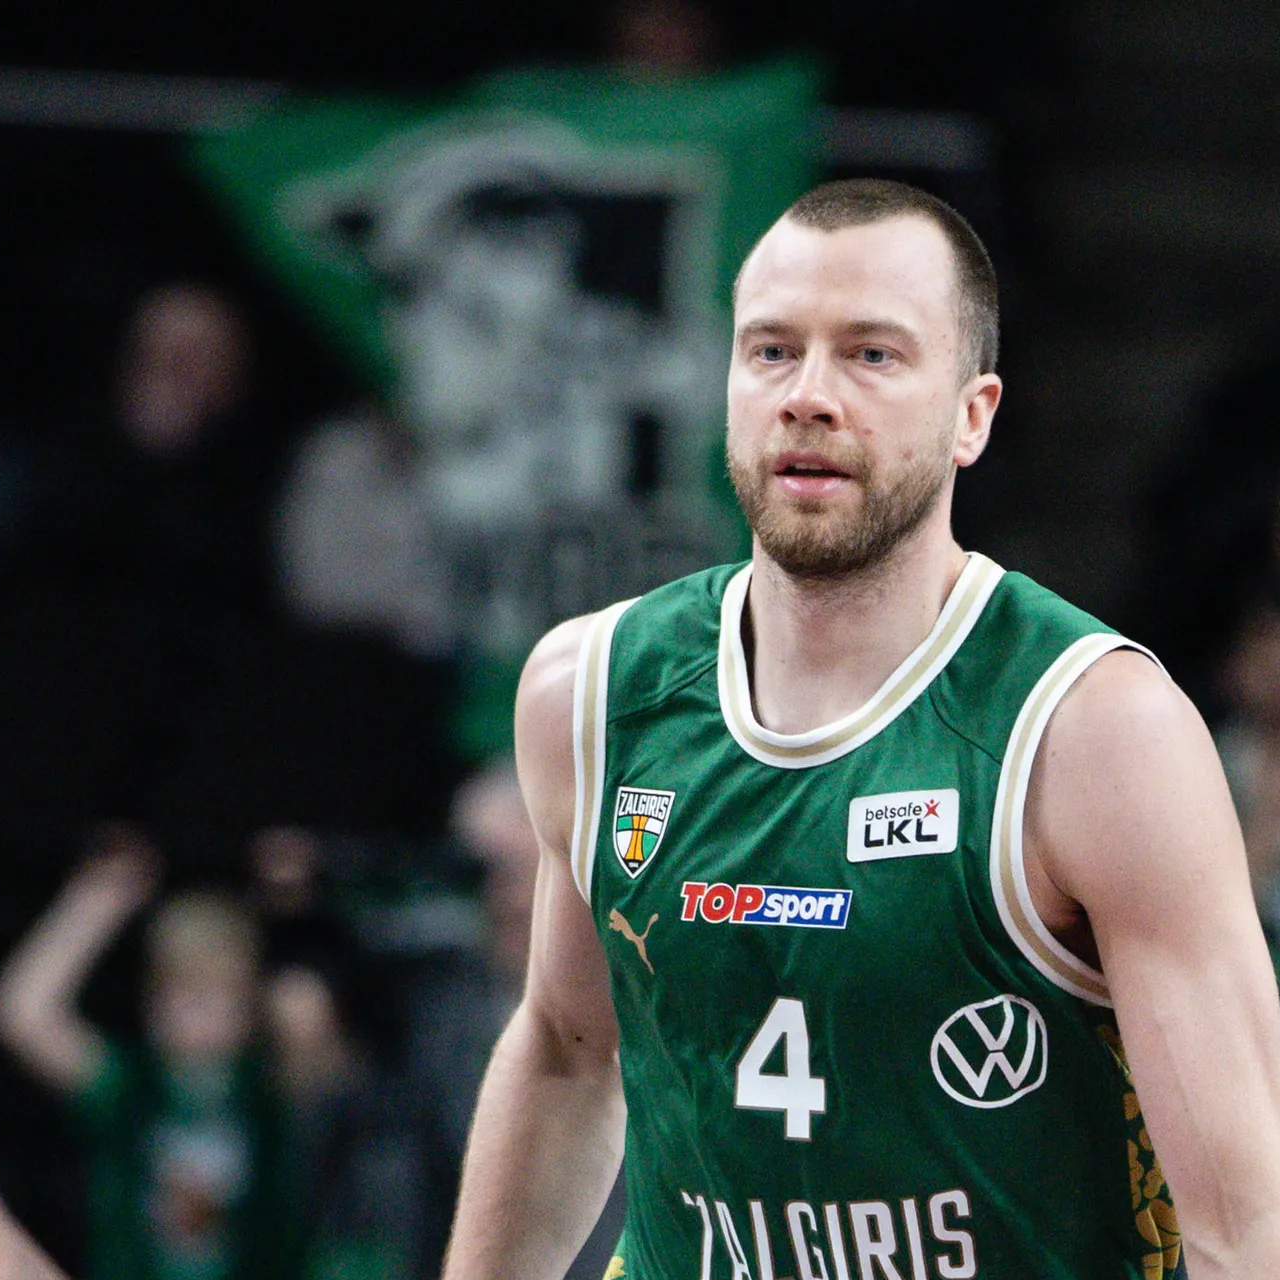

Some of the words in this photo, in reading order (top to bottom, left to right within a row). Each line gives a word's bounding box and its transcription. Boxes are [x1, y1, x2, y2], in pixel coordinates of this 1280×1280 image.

[865, 802, 923, 822] betsafe
[864, 818, 938, 849] LKL
[734, 996, 826, 1141] 4
